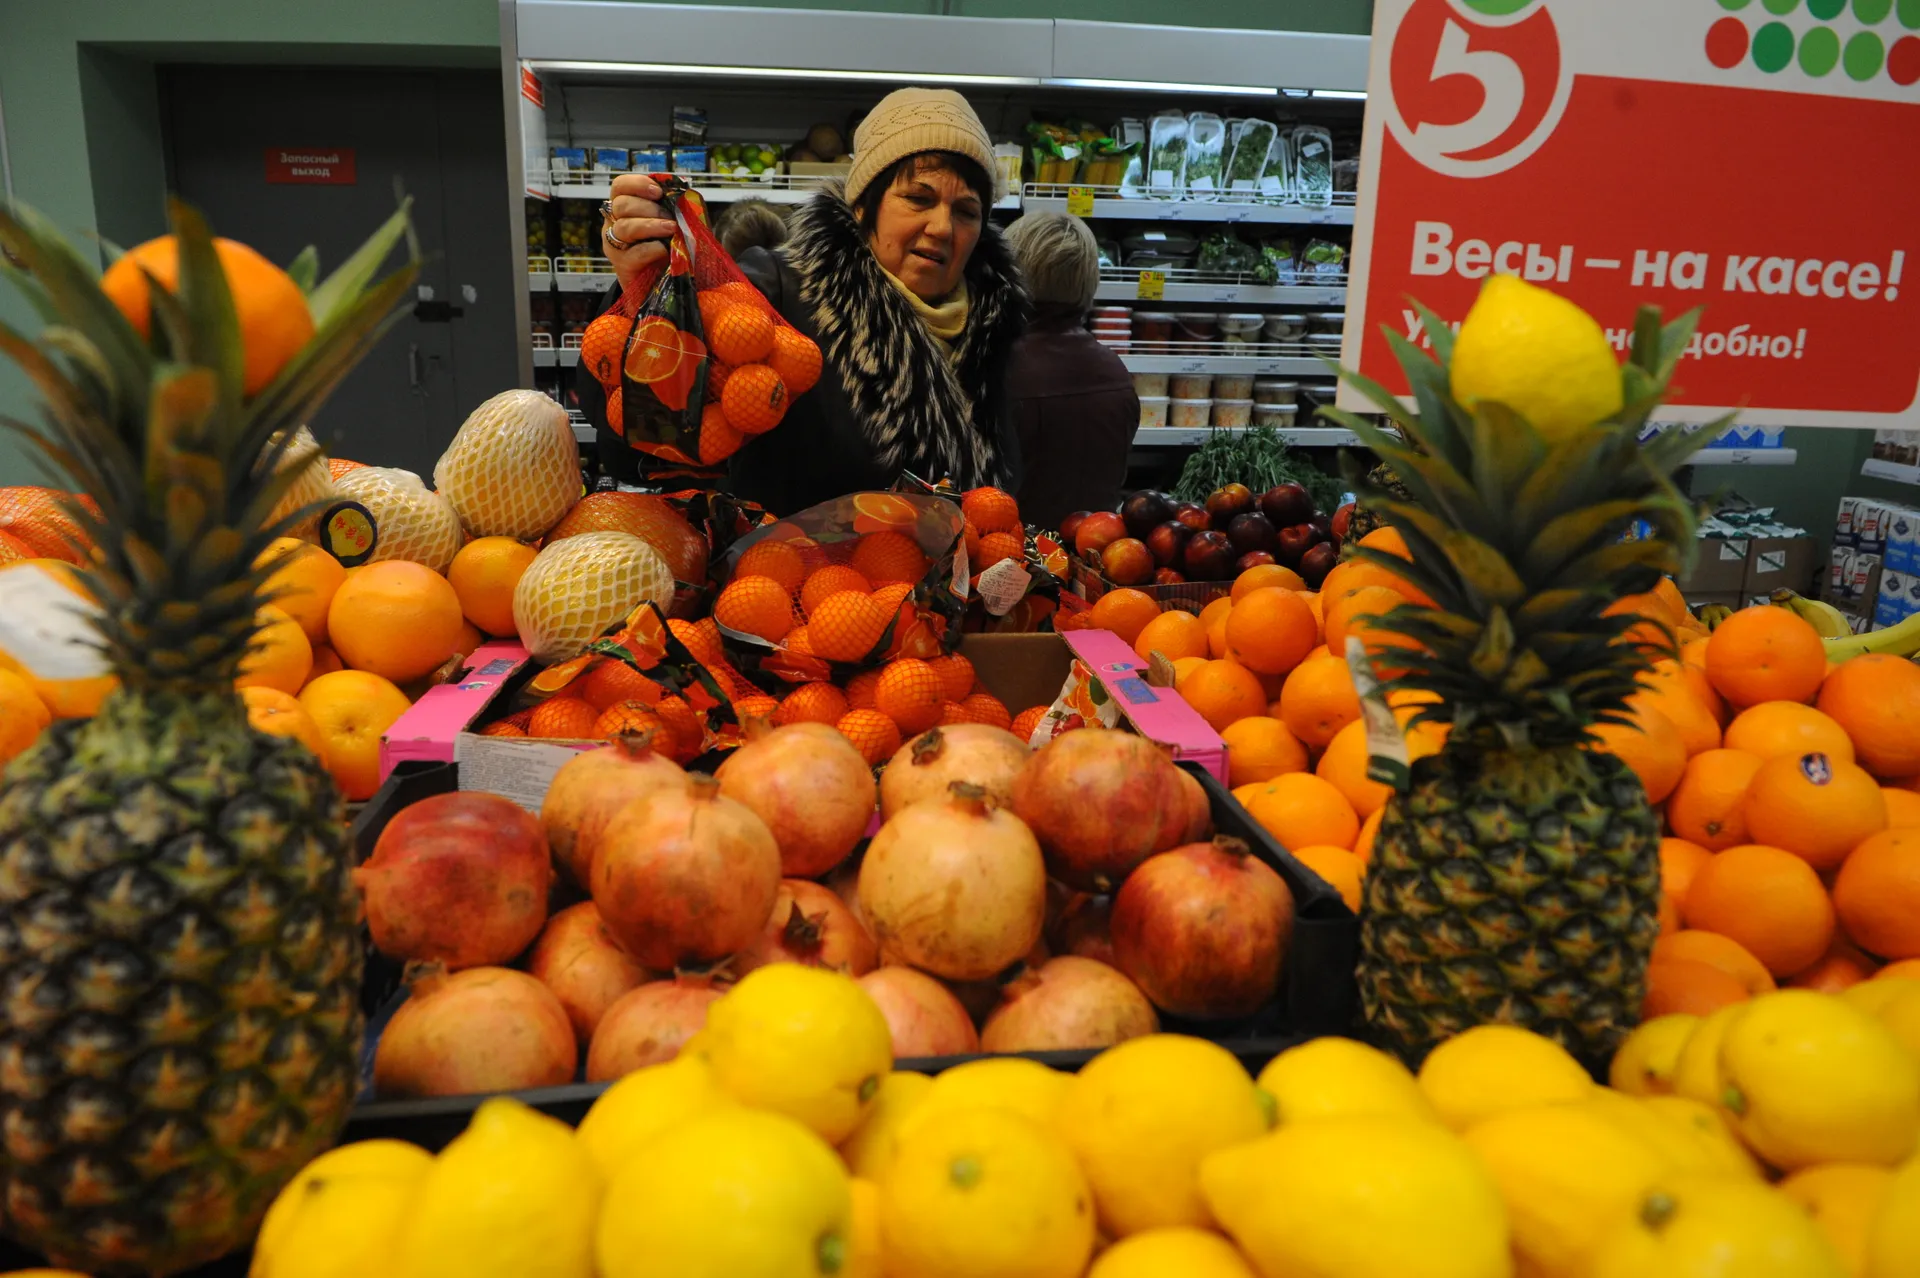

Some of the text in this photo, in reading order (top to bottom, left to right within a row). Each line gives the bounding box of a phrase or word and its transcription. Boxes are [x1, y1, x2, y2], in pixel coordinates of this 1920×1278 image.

[1413, 17, 1525, 154] 5
[292, 167, 331, 178] выход
[1410, 221, 1574, 283] Весы
[1630, 249, 1708, 290] на
[1723, 250, 1906, 302] кассе!
[1677, 323, 1808, 361] добно!
